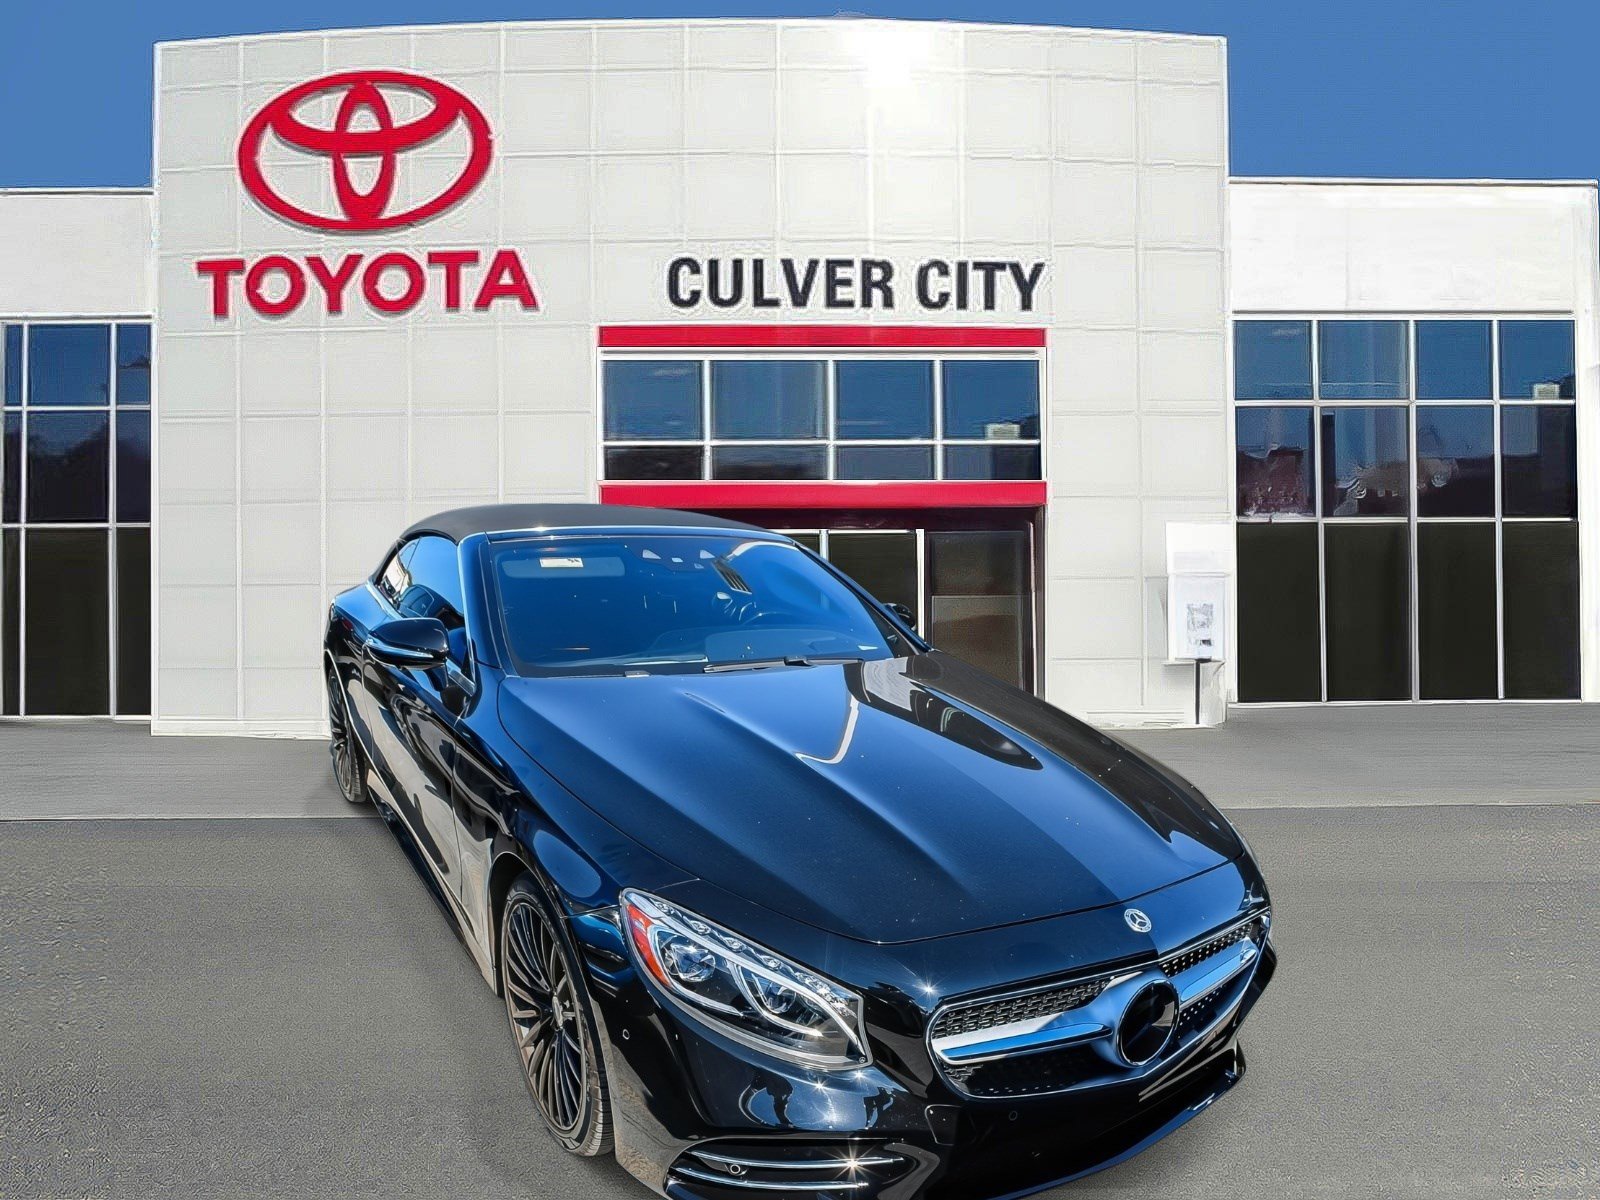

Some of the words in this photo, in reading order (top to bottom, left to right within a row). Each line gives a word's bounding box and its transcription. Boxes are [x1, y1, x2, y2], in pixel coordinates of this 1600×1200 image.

[196, 249, 538, 317] TOYOTA
[668, 256, 894, 309] CULVER
[916, 259, 1046, 312] CITY
